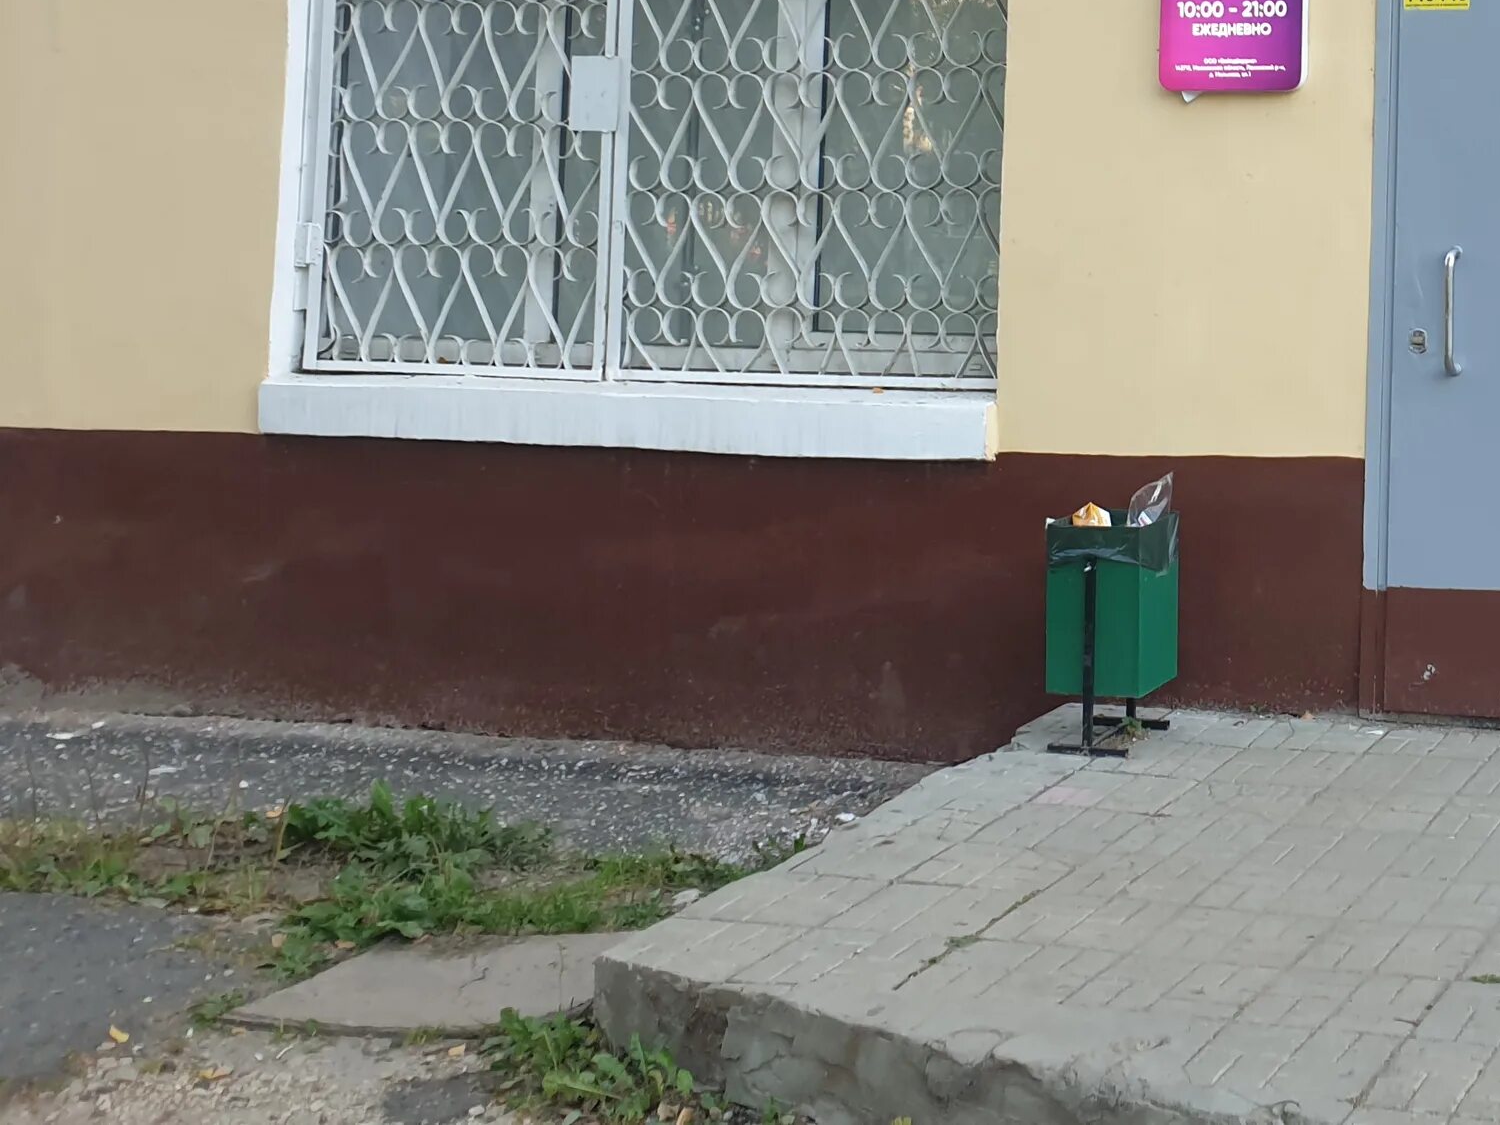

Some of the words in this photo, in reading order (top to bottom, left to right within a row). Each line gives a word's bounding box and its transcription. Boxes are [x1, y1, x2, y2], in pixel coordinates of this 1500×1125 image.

[1177, 1, 1225, 18] 10:00
[1241, 0, 1288, 17] 21:00
[1192, 23, 1272, 37] ЕЖЕДНЕВНО
